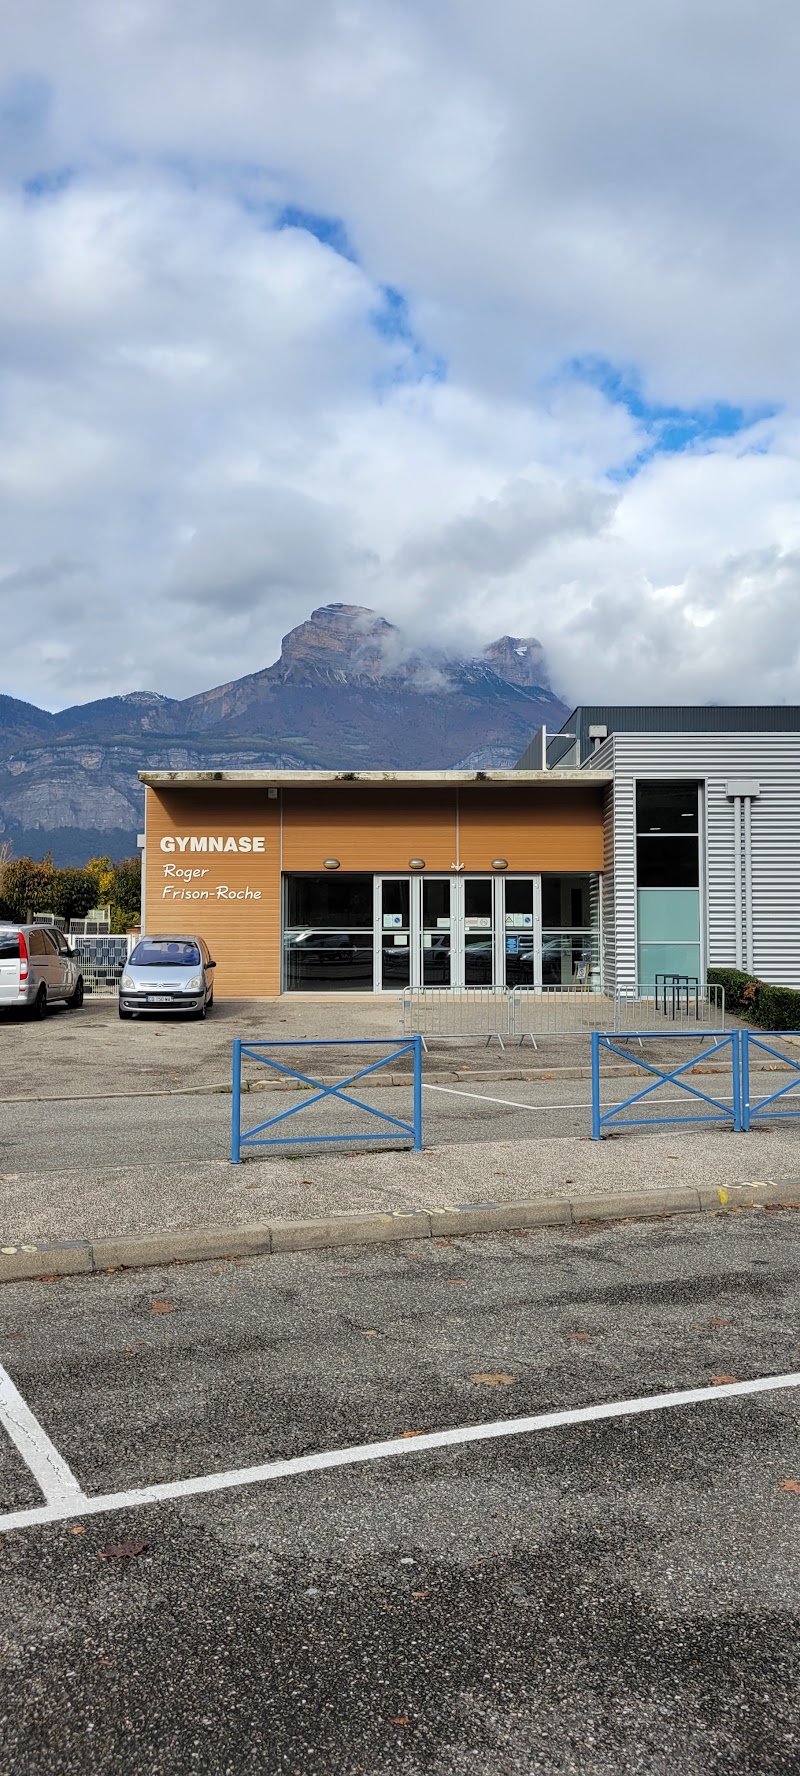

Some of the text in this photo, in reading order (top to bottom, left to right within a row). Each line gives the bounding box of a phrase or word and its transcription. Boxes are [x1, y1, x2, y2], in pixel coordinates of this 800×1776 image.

[160, 836, 266, 853] GYMNASE
[162, 863, 210, 883] Roger
[162, 885, 262, 900] Frison-Roche
